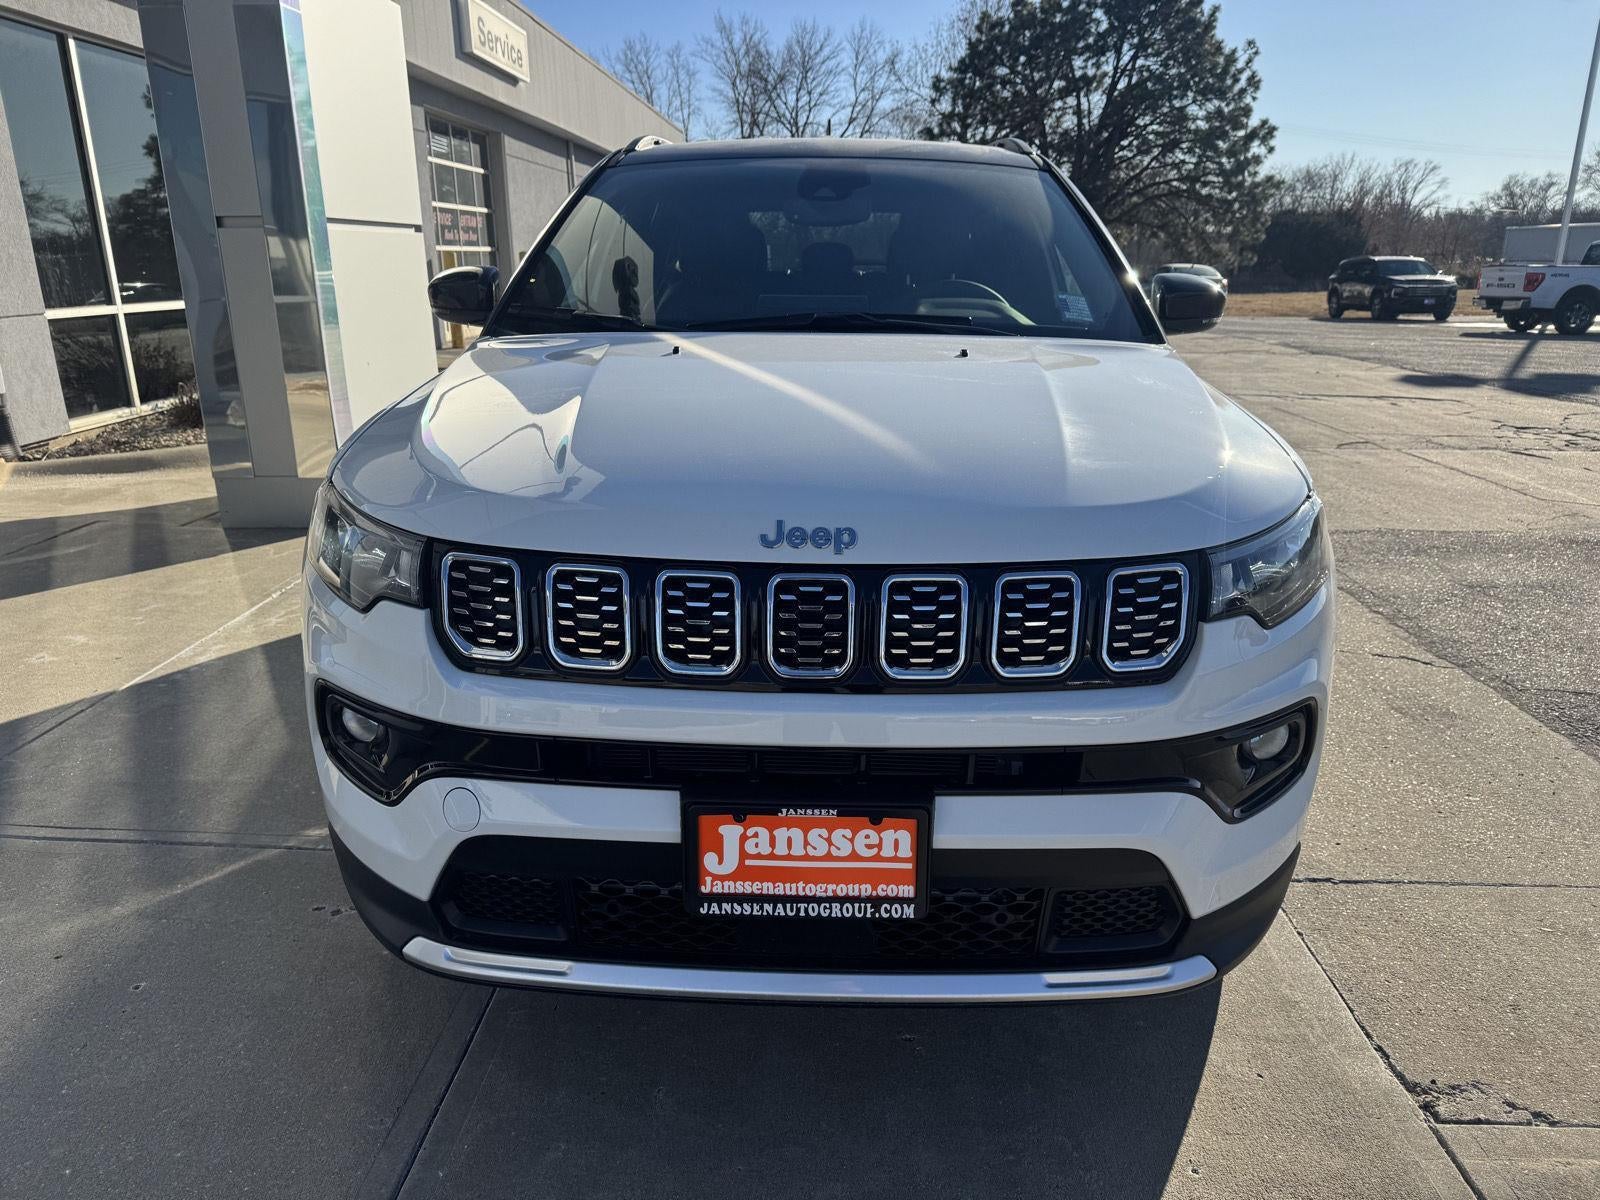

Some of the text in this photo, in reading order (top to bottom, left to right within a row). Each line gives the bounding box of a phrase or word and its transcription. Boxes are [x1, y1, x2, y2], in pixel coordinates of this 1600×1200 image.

[477, 15, 523, 69] Service
[759, 519, 859, 555] Jeep
[778, 808, 838, 817] JANSSEN
[703, 824, 913, 875] Janssen
[701, 876, 915, 899] Janssenautogroup.com
[700, 902, 915, 919] JANSSENAUTOGROUP.COM
